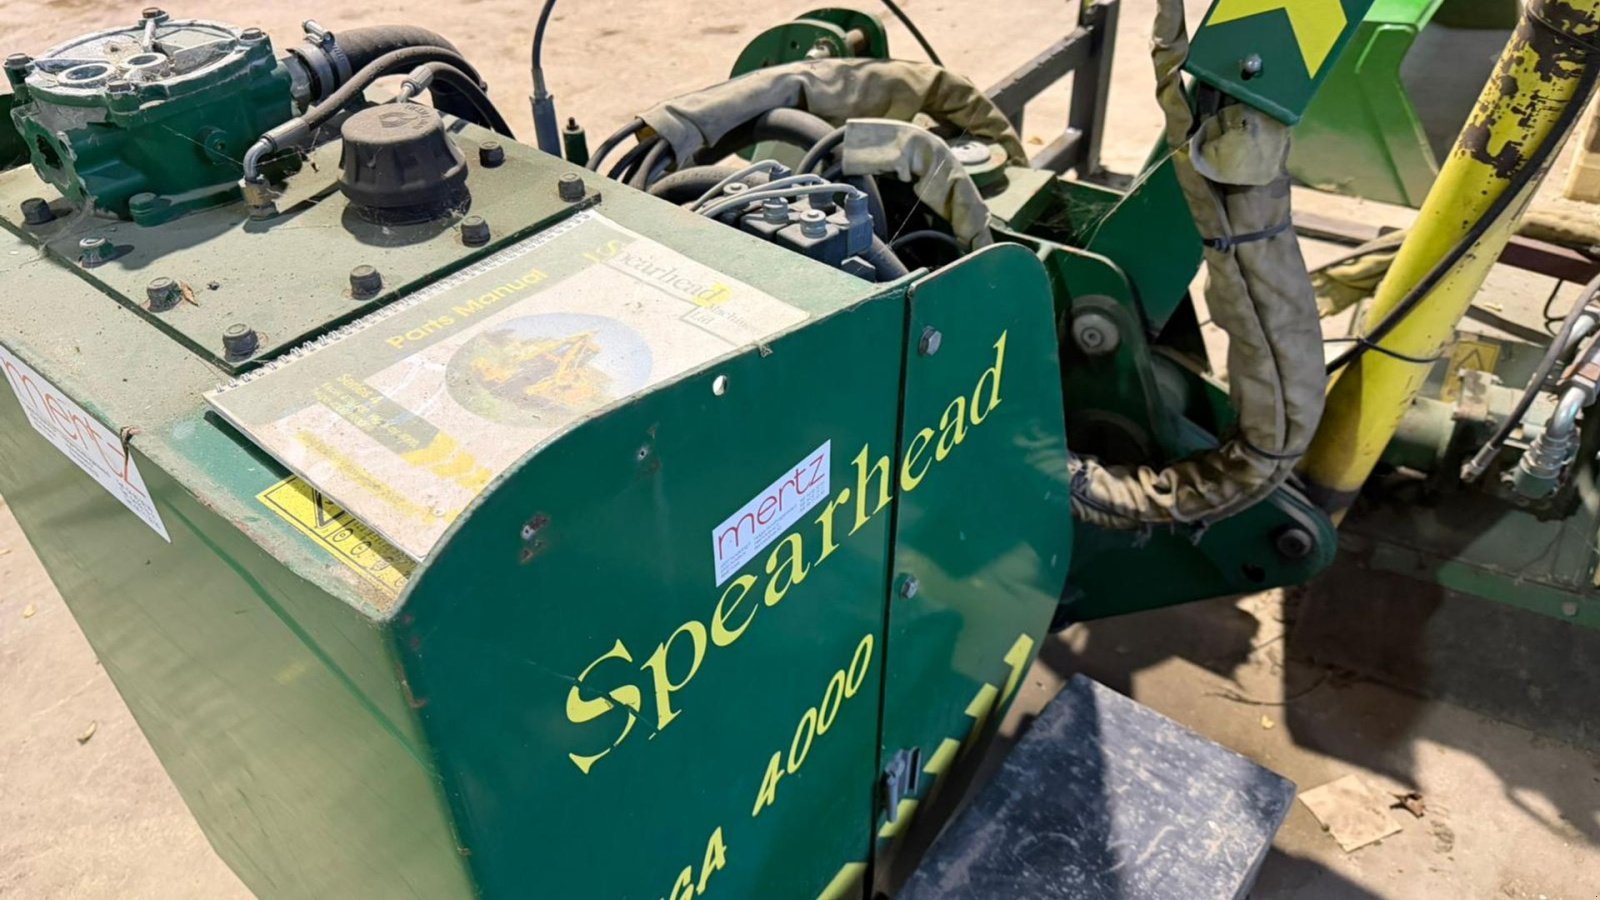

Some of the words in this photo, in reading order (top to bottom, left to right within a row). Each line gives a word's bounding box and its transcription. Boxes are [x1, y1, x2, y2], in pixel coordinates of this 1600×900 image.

[385, 314, 455, 350] Parts
[452, 268, 548, 317] Manual
[0, 355, 147, 498] mertz
[566, 329, 1007, 774] Spearhead
[718, 453, 825, 561] mertz
[660, 825, 727, 900] GA
[752, 633, 874, 817] 4000
